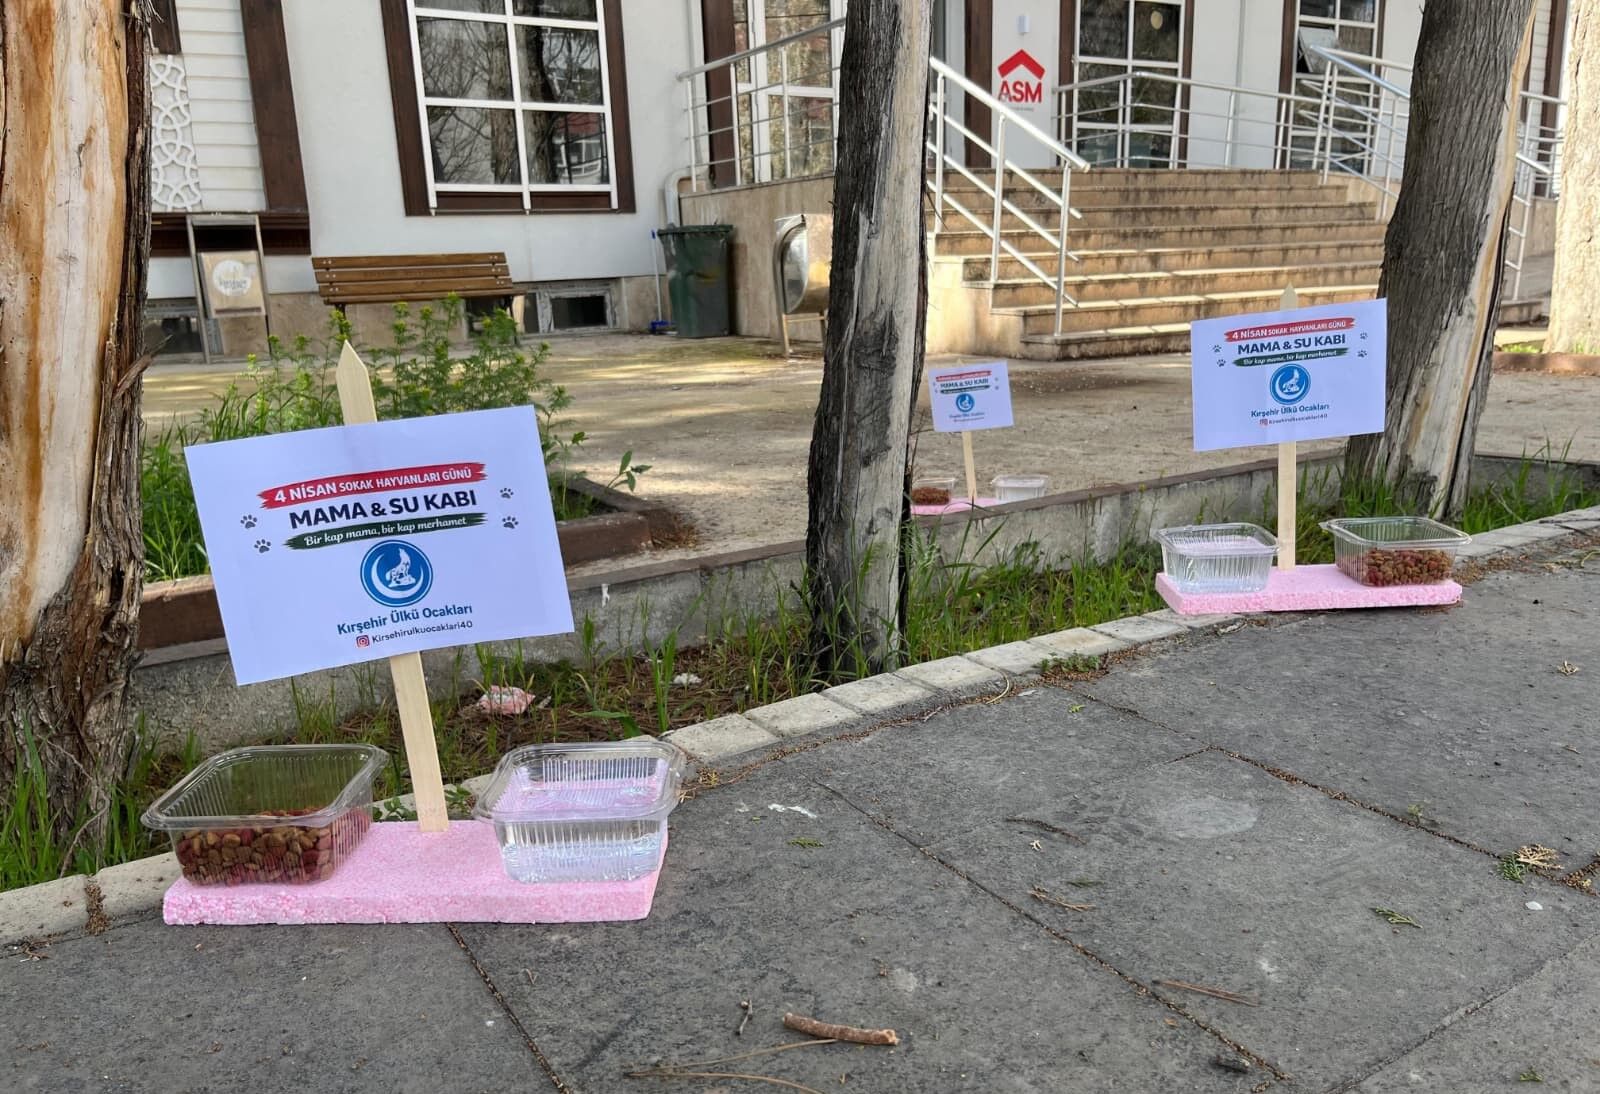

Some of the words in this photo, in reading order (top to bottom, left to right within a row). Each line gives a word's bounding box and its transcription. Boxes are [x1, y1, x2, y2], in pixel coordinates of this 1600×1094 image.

[998, 80, 1042, 103] ASM
[1232, 331, 1239, 340] 4
[1240, 327, 1268, 338] NİSAN
[1238, 340, 1281, 355] MAMA
[1282, 340, 1292, 350] &
[1293, 338, 1312, 349] SU
[1314, 334, 1346, 347] KABI
[1250, 408, 1280, 418] Kırşehir
[1281, 404, 1298, 414] Ülkü
[1299, 402, 1330, 412] Ocakları
[274, 490, 286, 503] 4
[290, 482, 337, 500] NİSAN
[339, 479, 374, 492] SOKAK
[376, 471, 441, 488] HAYVANLARI
[442, 467, 472, 481] GÜNÜ
[289, 502, 368, 529] MAMA
[371, 500, 386, 516] &
[389, 495, 420, 514] SU
[424, 489, 477, 509] KABI
[304, 533, 322, 546] Bir
[324, 530, 343, 545] kap
[345, 526, 381, 539] mama,
[381, 522, 395, 534] bir
[396, 520, 415, 535] kap
[417, 516, 467, 530] merhamet
[337, 615, 388, 636] Kırşehir
[390, 607, 419, 624] Ülkü
[422, 603, 472, 619] Ocakları
[372, 620, 473, 644] Kirsehirulkuocaklari40
